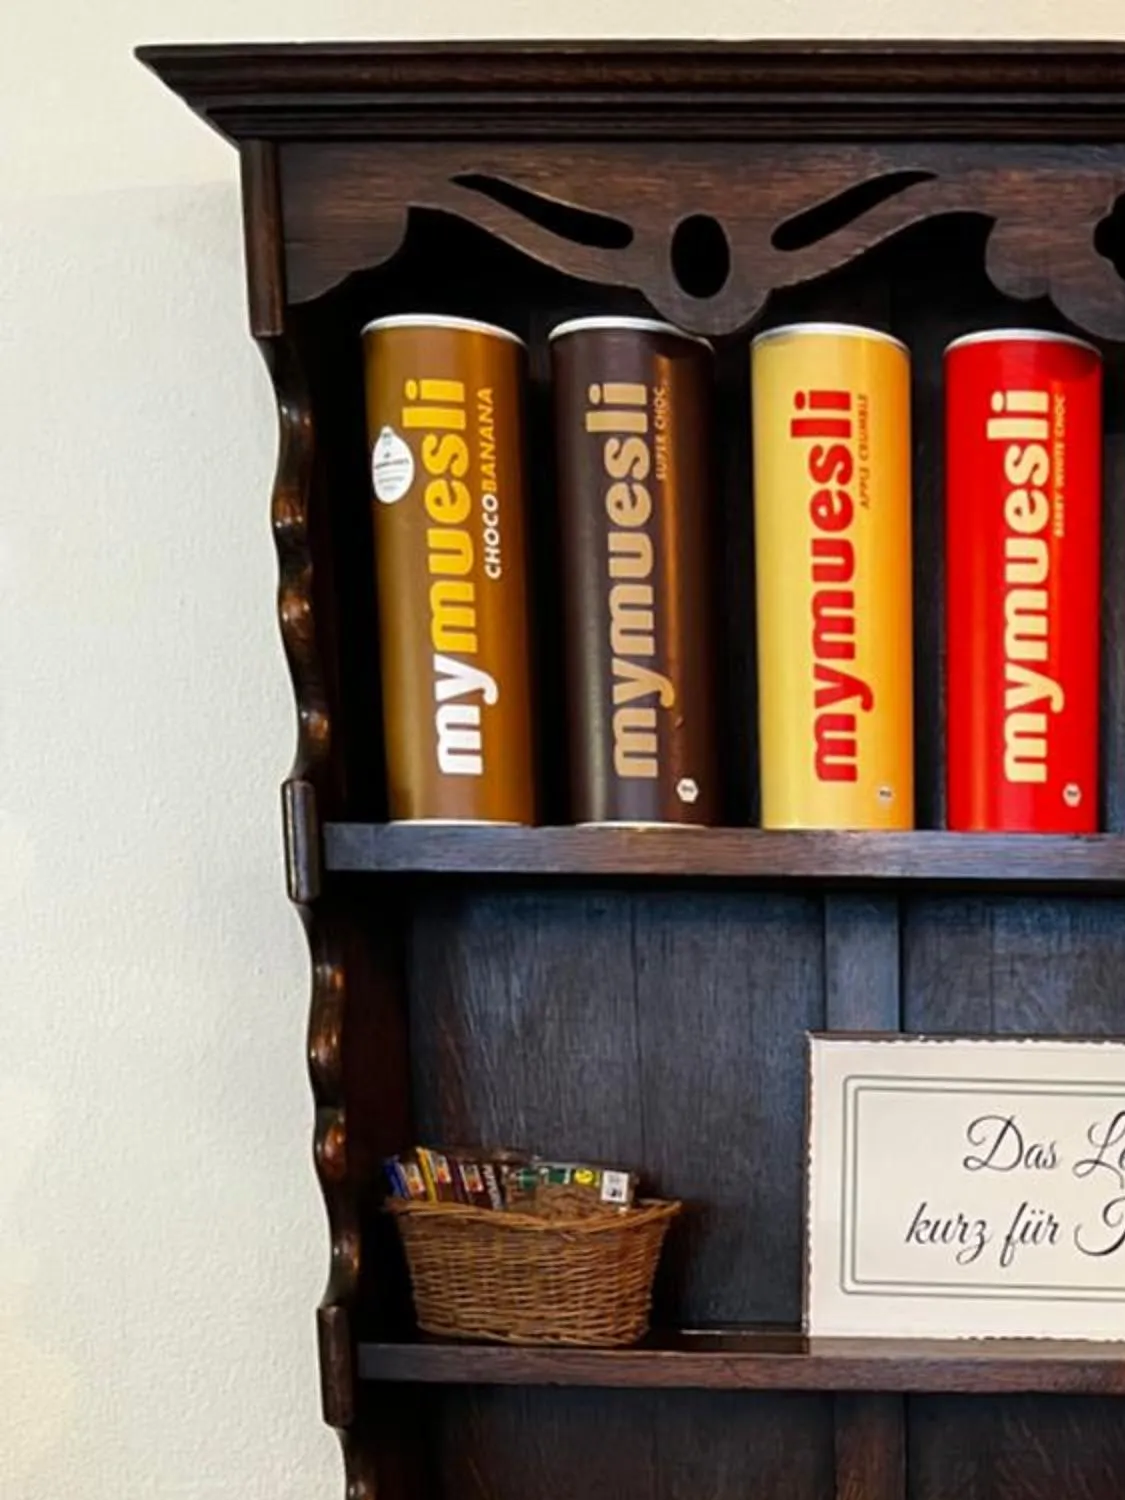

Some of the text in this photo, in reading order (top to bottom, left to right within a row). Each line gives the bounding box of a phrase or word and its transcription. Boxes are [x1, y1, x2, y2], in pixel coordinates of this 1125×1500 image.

[402, 379, 498, 775] mymuesli
[476, 387, 502, 580] CHOCOBANANA
[586, 382, 674, 778] mymuesli
[791, 390, 873, 782] mymuesli
[987, 390, 1064, 783] mymuesli
[904, 1201, 990, 1266] kurz
[1000, 1201, 1060, 1268] für
[963, 1114, 1058, 1172] Das
